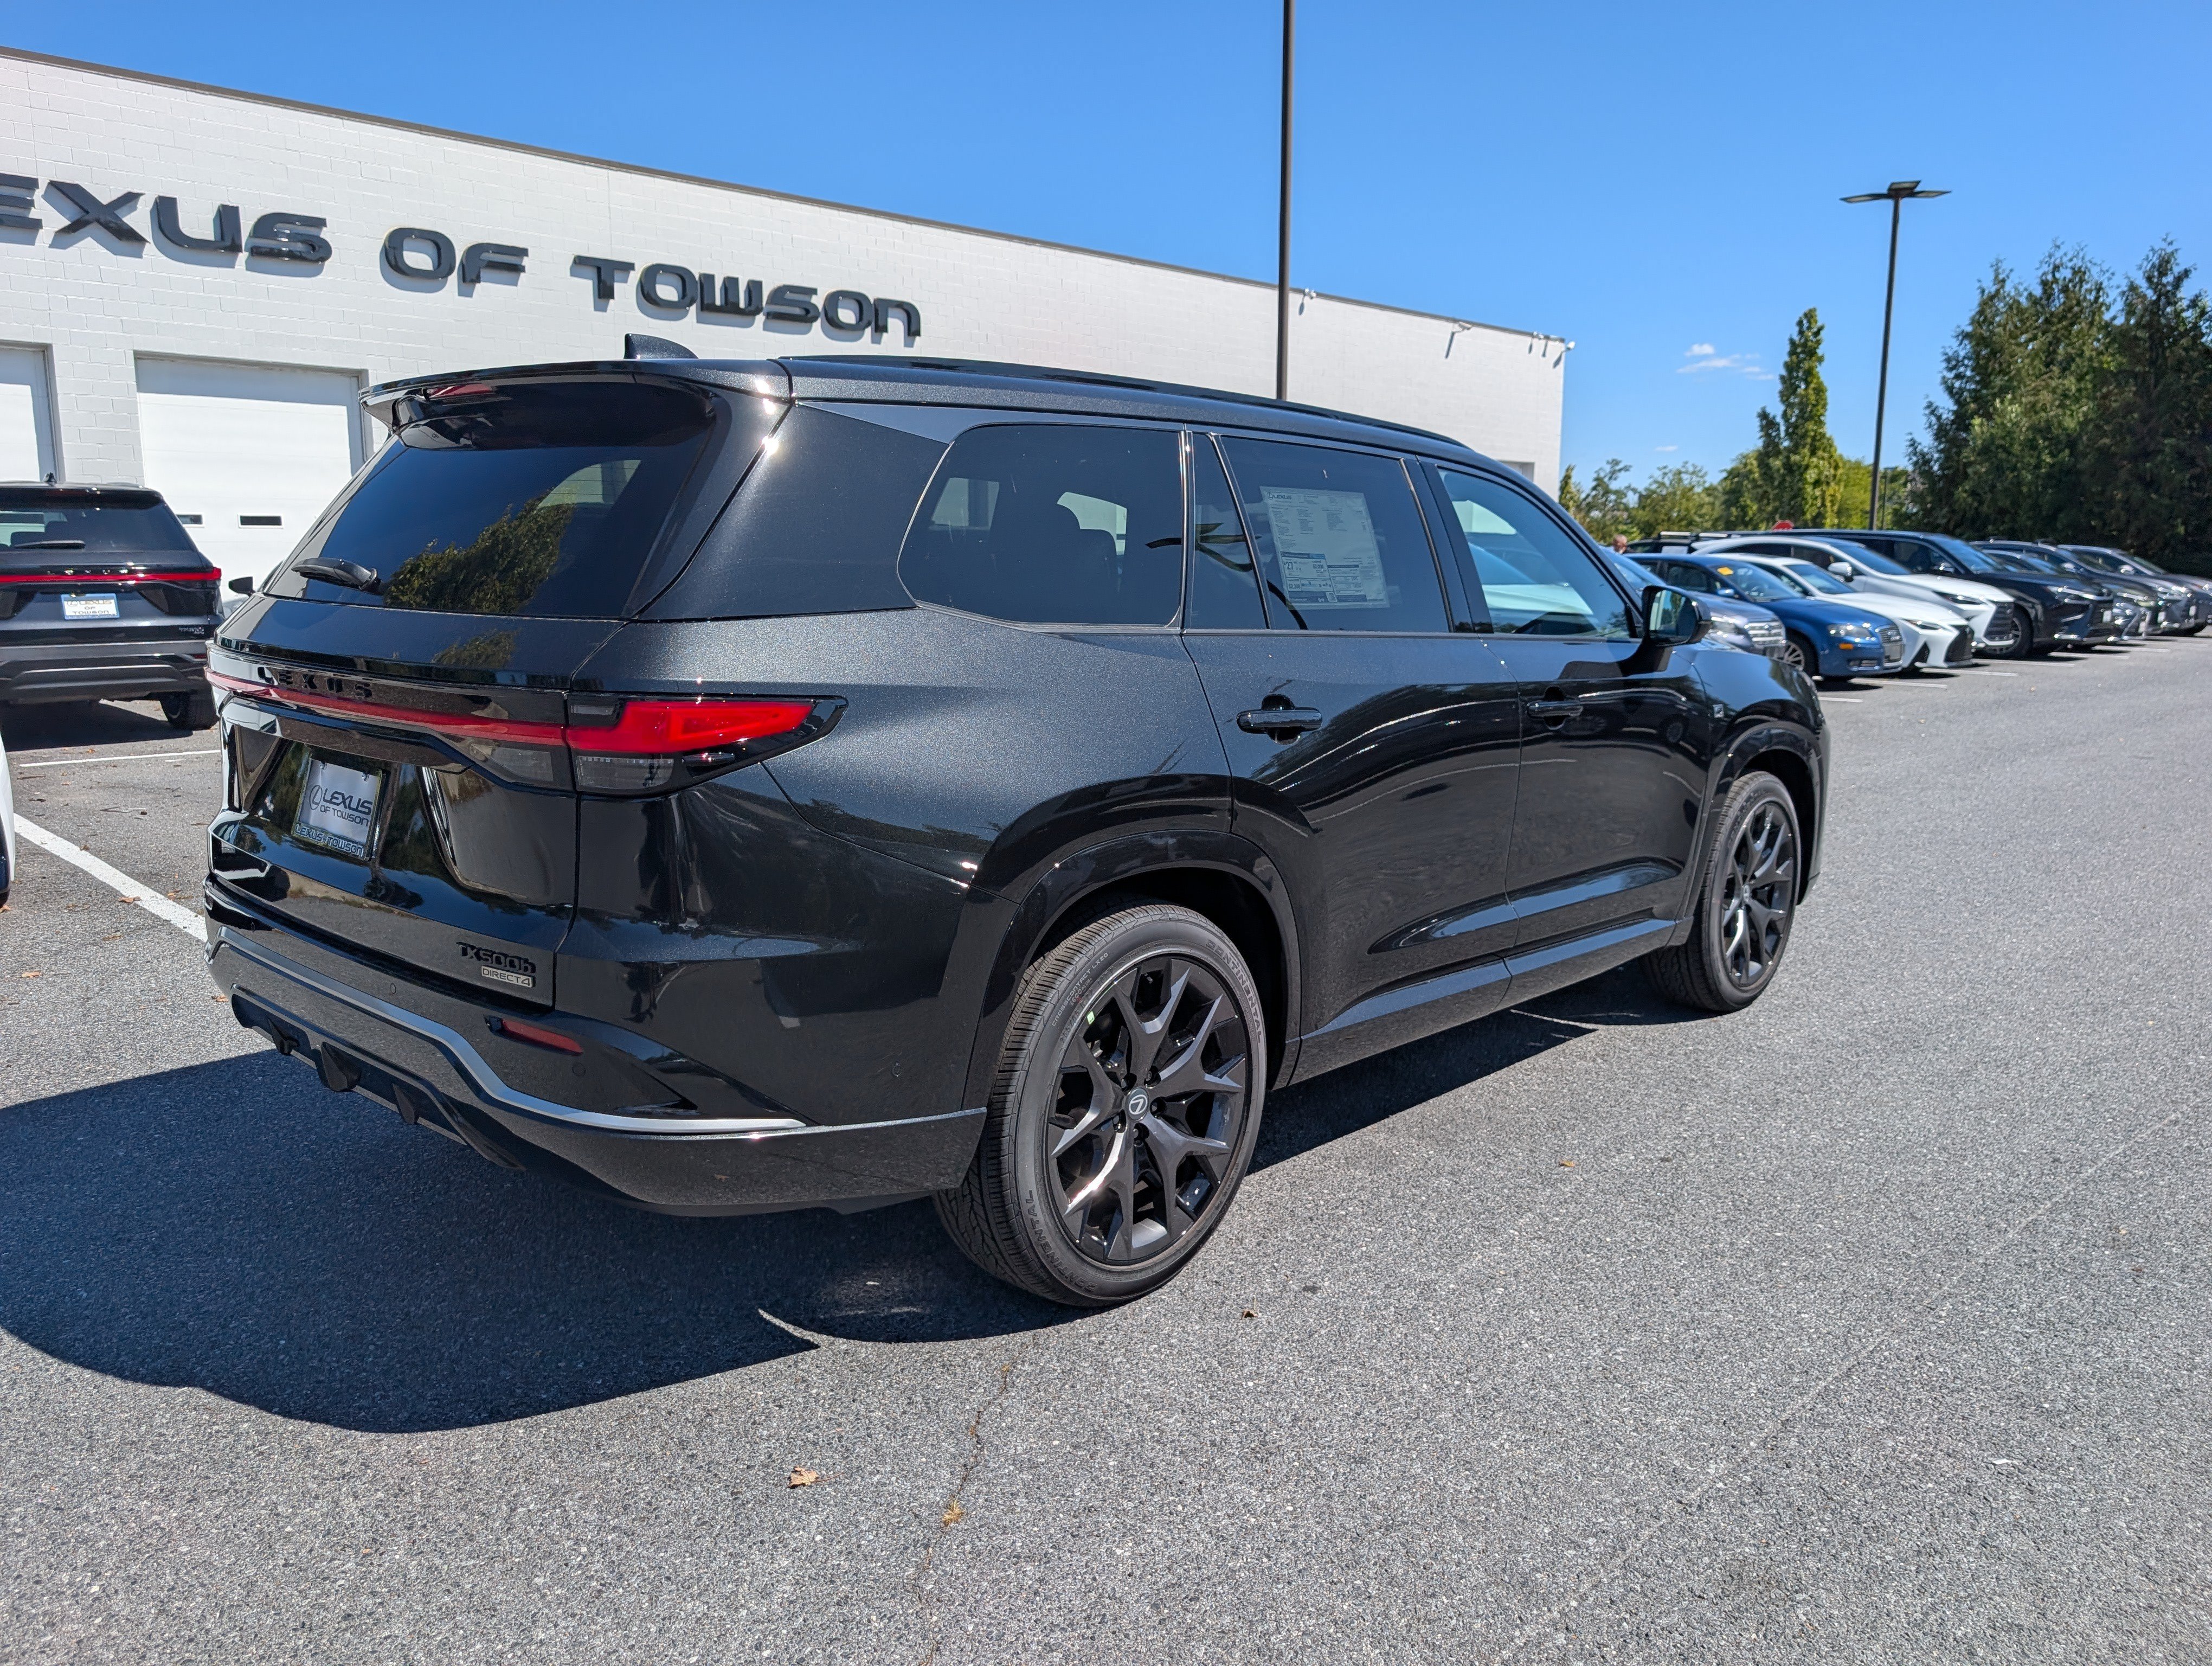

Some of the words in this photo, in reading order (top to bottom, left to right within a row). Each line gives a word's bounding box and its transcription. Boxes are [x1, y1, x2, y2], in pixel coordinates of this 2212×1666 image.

[384, 227, 529, 284] OF
[573, 254, 921, 337] TOWSON
[257, 667, 372, 698] LEXUS
[320, 804, 331, 813] OF
[331, 808, 369, 827] TOWSON
[323, 788, 373, 816] LEXUS
[295, 824, 324, 842] LEXUS
[326, 835, 364, 857] TOWSON
[456, 941, 536, 974] TX500h
[482, 967, 531, 986] DIRECT4
[1051, 970, 1091, 1027] CROSSCONTACT
[1091, 952, 1109, 969] LX20
